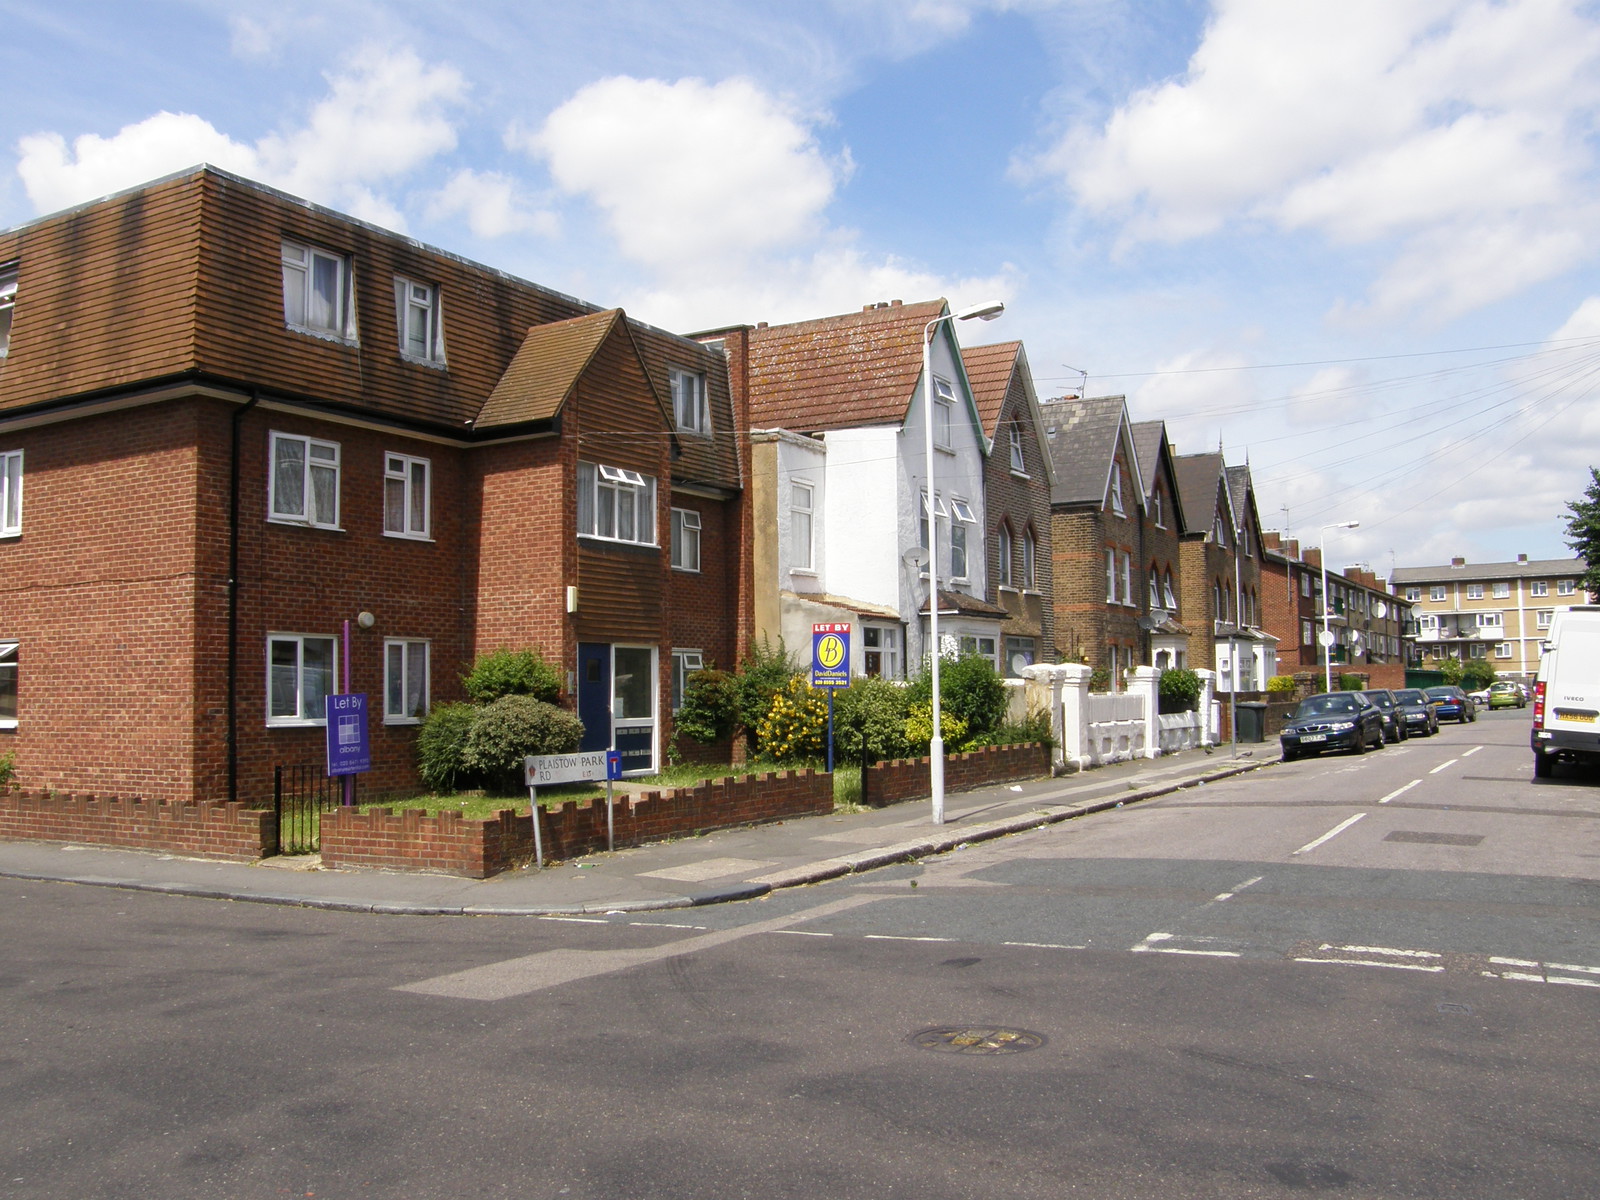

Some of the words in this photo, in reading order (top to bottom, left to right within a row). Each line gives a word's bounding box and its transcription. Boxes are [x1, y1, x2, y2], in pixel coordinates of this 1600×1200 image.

[334, 696, 350, 710] Let
[351, 696, 362, 710] By
[340, 746, 360, 754] albany
[539, 757, 577, 770] PLAISTOW
[581, 756, 604, 766] PARK
[540, 771, 551, 781] RD
